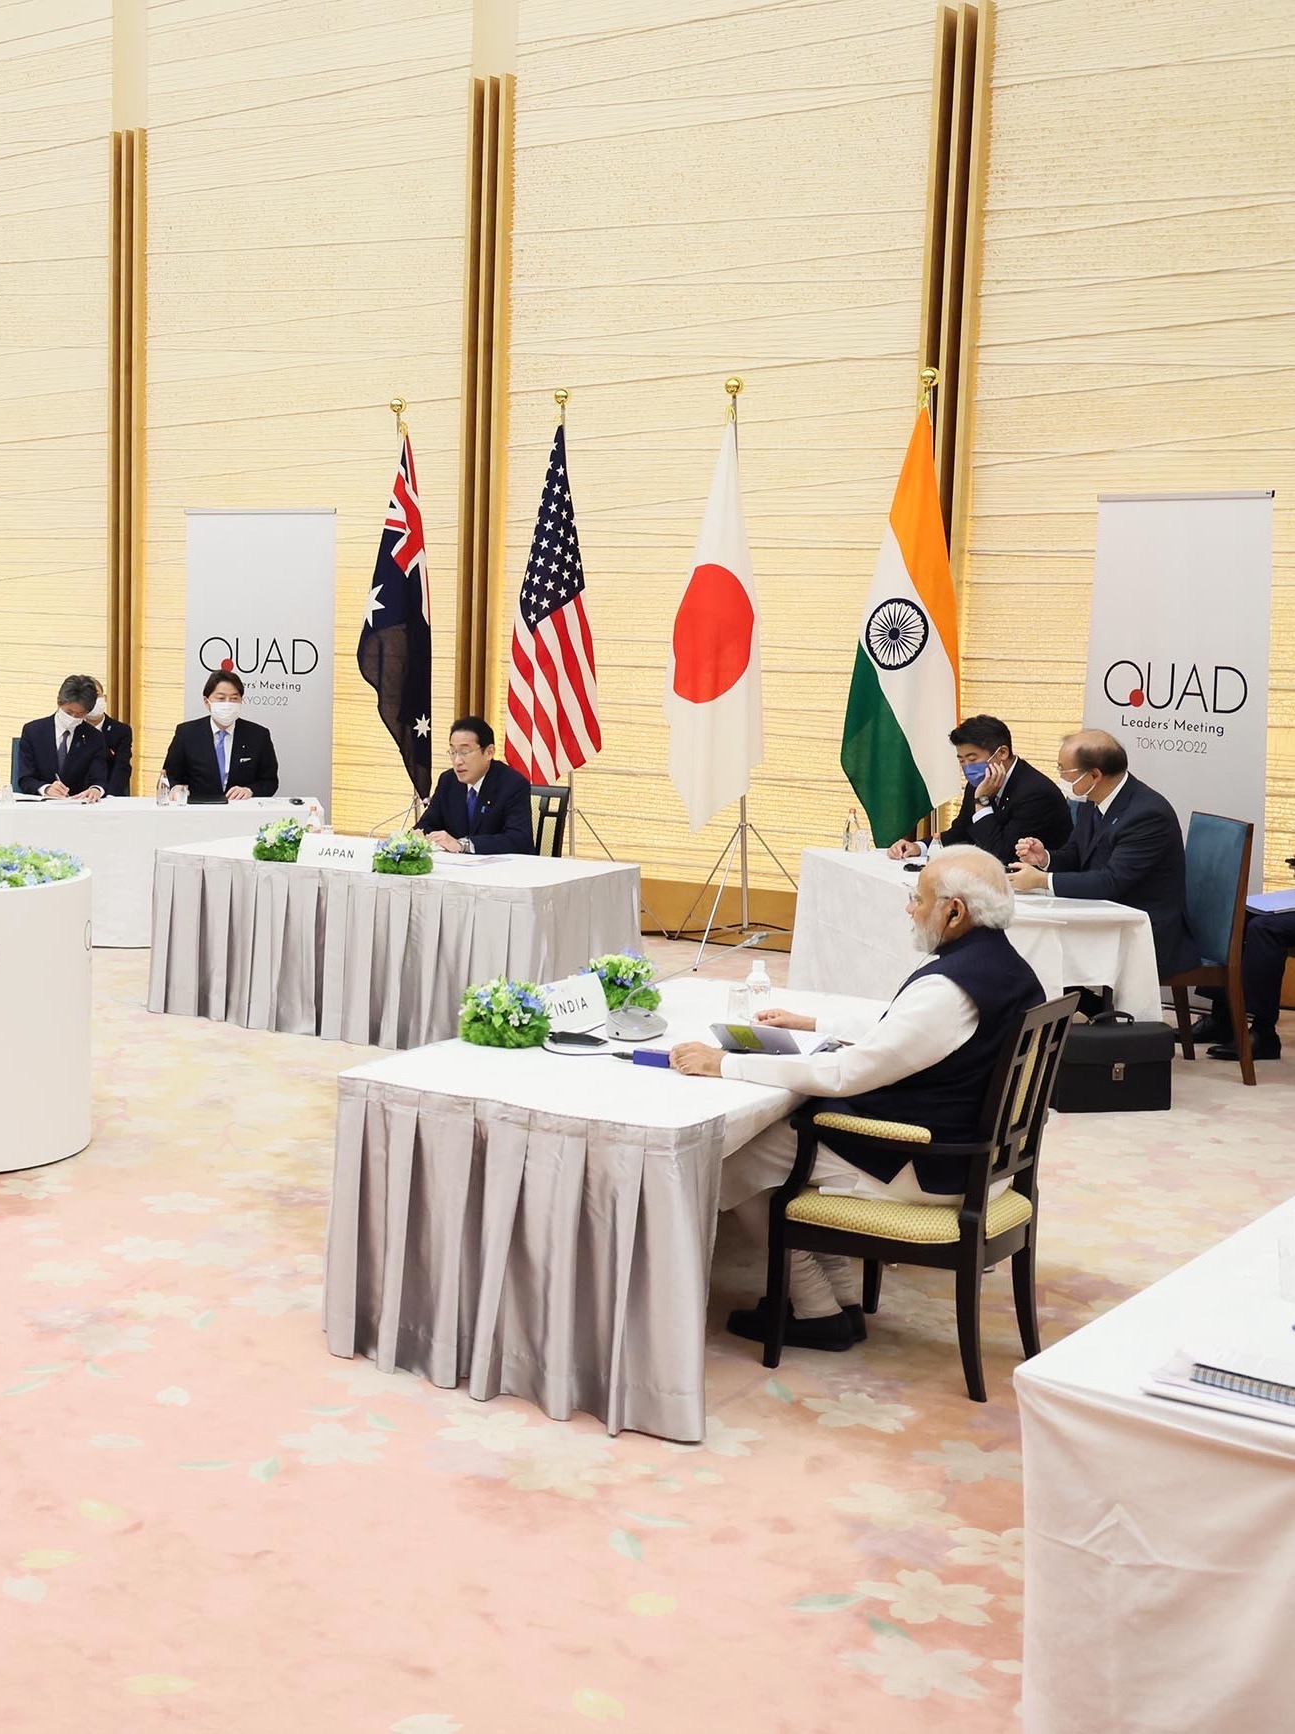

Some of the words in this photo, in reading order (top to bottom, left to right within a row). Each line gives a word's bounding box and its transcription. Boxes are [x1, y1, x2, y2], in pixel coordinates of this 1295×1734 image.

[199, 637, 318, 674] QUAD
[260, 681, 301, 692] Meeting
[1104, 660, 1248, 714] QUAD
[1121, 715, 1171, 730] Leaders'
[1174, 719, 1224, 737] Meeting
[1136, 736, 1208, 754] TOKYO2022
[318, 848, 355, 859] JAPAN
[554, 997, 589, 1016] INDIA
